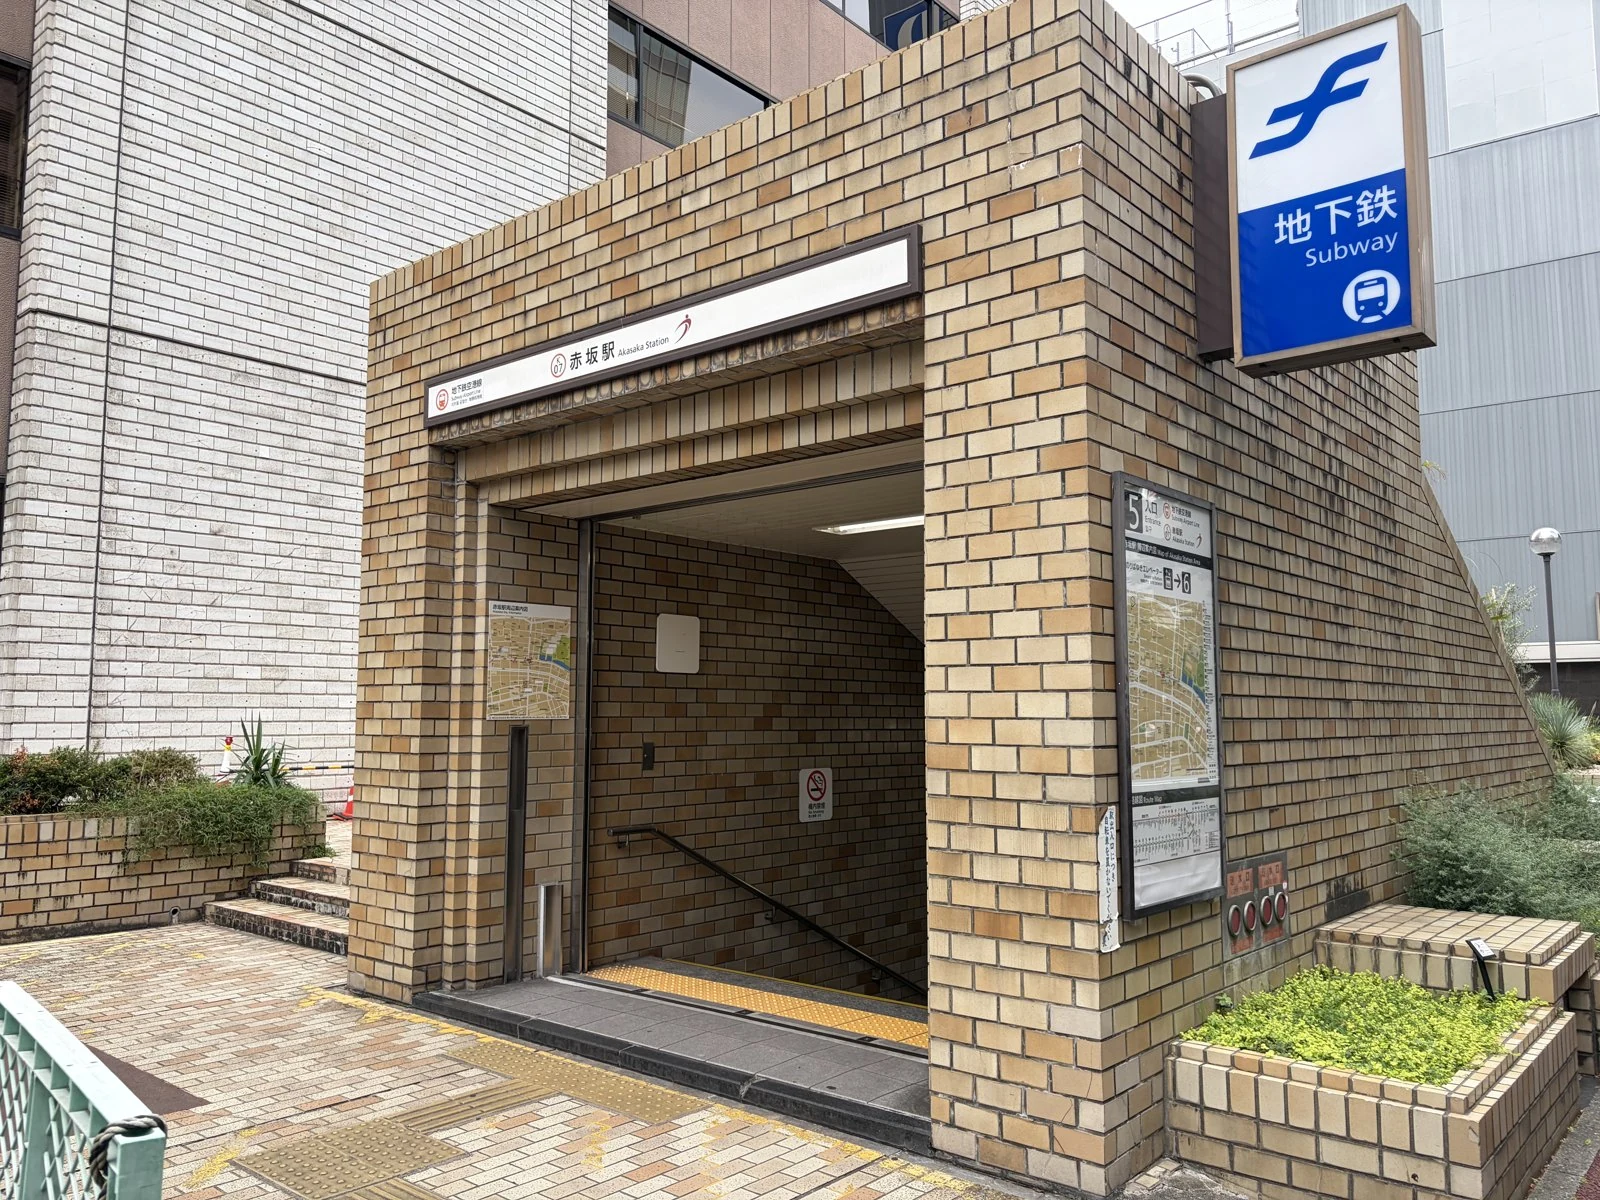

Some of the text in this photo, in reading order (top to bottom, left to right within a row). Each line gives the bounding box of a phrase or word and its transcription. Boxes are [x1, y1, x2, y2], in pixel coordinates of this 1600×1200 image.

[1274, 184, 1398, 246] 地下鉄
[1305, 232, 1398, 267] Subway
[570, 341, 615, 370] 赤坂駅
[618, 336, 669, 357] Akasaka Station
[554, 363, 563, 374] 07
[452, 378, 483, 394] 地下鉄空港線
[1129, 494, 1140, 530] 5
[1145, 500, 1158, 515] 入口
[1145, 516, 1162, 526] Entrance
[1184, 574, 1190, 593] 6
